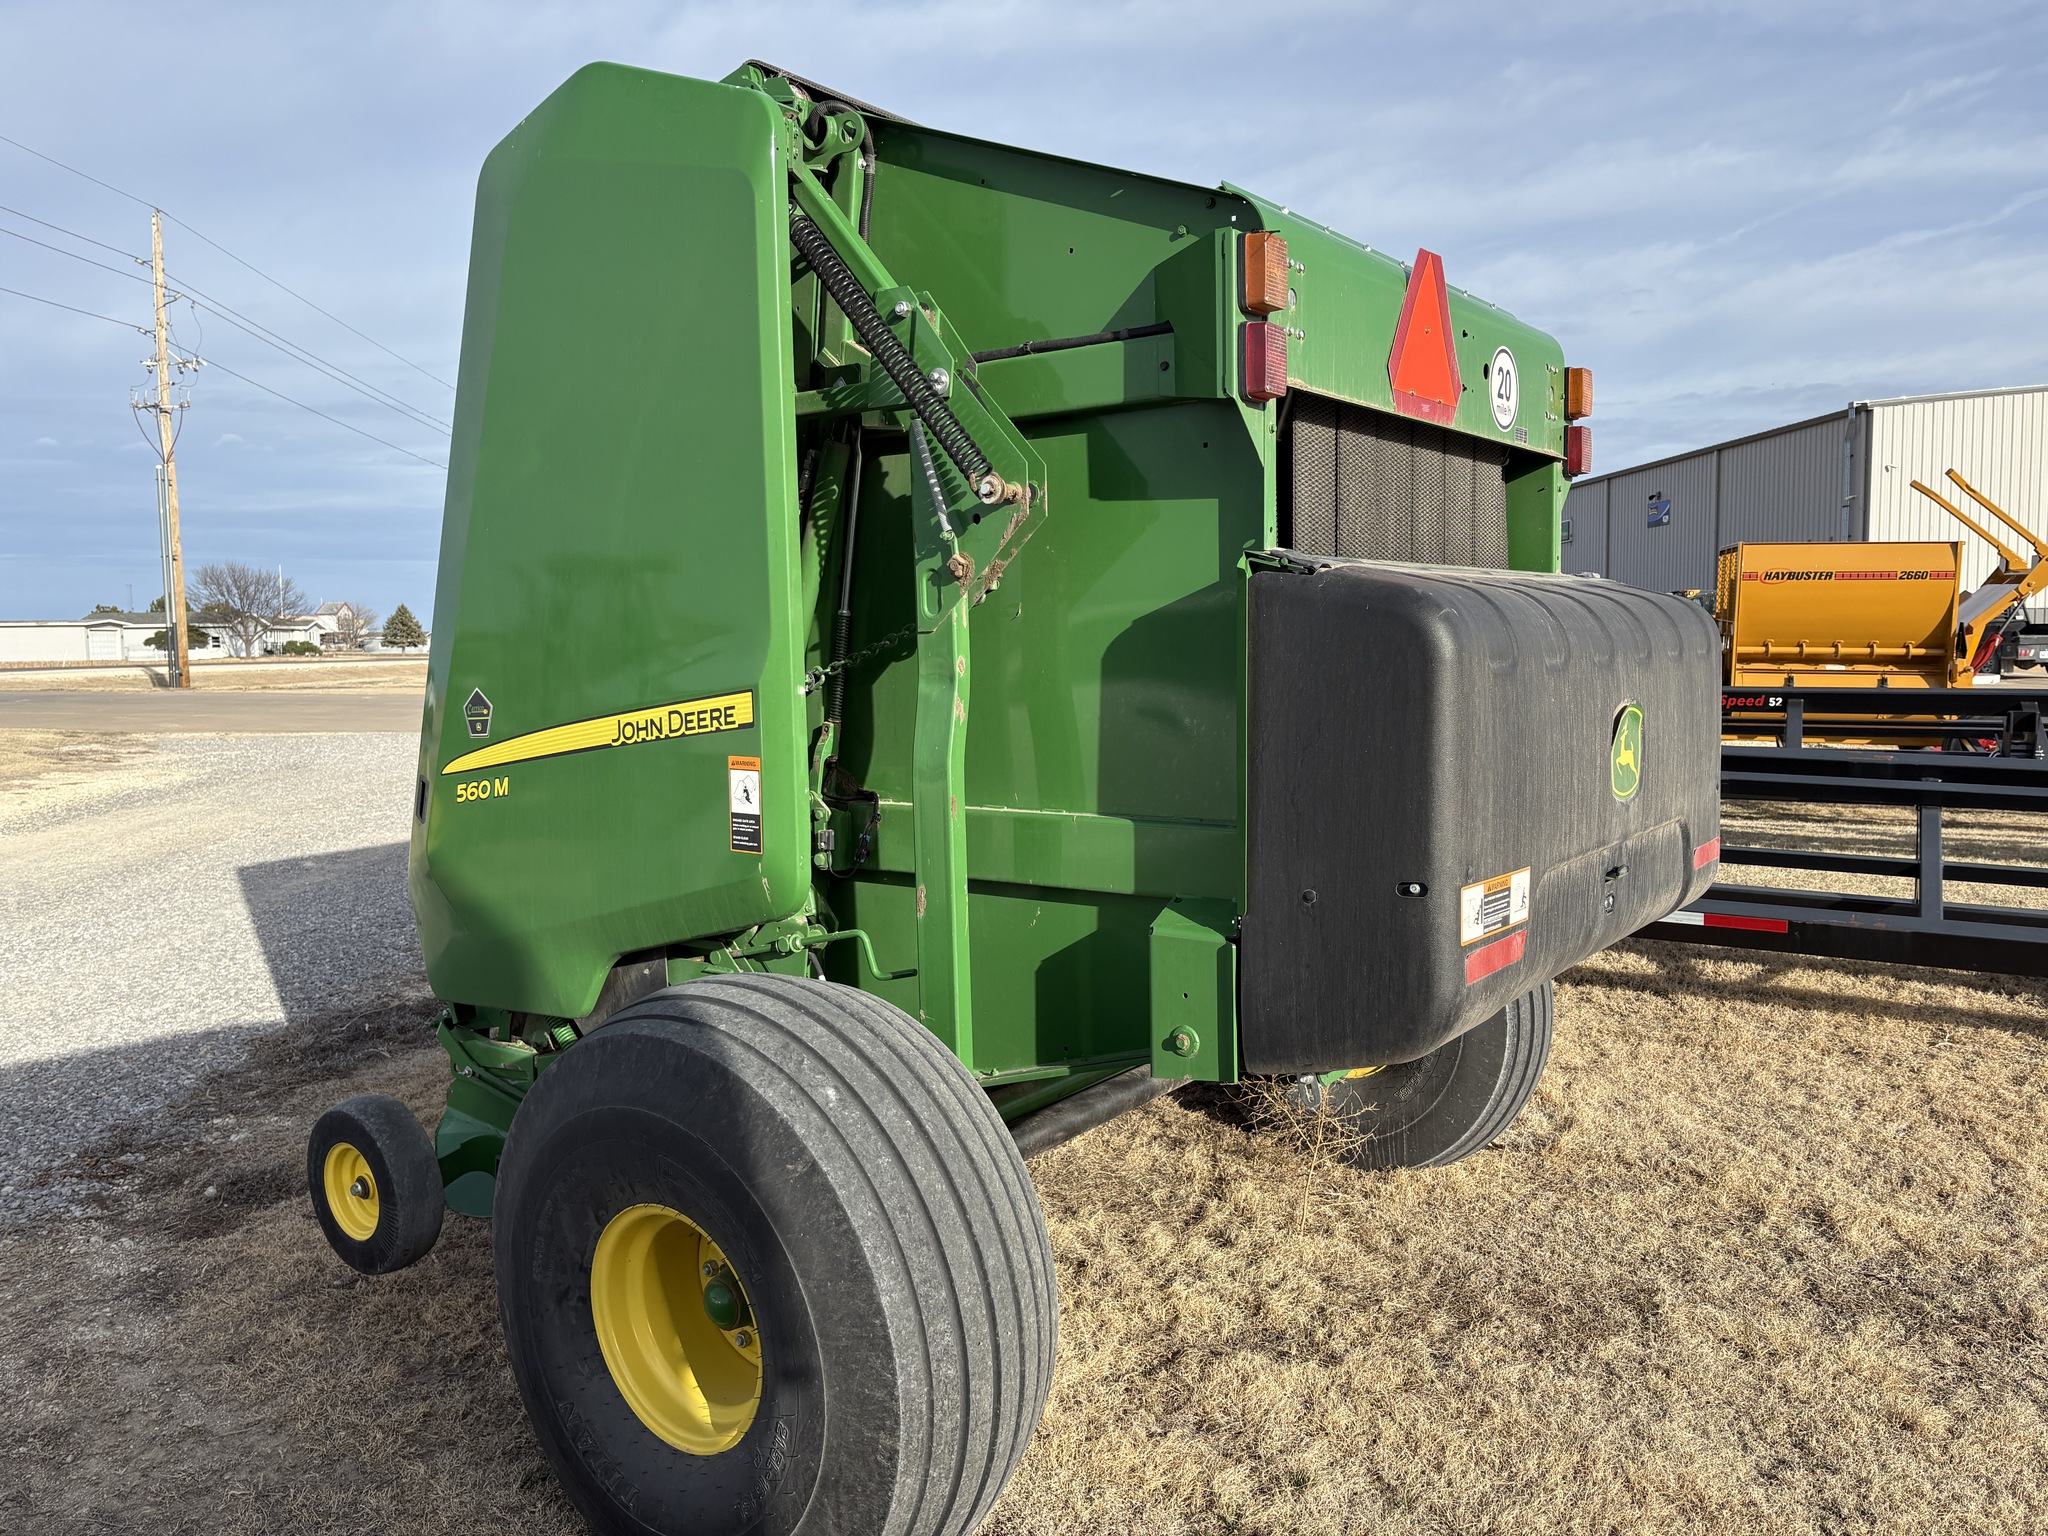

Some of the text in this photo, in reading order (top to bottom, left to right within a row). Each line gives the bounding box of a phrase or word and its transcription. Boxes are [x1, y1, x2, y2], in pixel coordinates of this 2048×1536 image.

[1497, 366, 1512, 403] 20
[1762, 570, 1929, 581] HAYBUSTER 2660
[1768, 697, 1783, 707] 52
[612, 705, 737, 744] JOHN DEERE
[735, 760, 757, 768] WARNING
[456, 776, 510, 803] 560 M
[558, 1402, 642, 1511] TITAN
